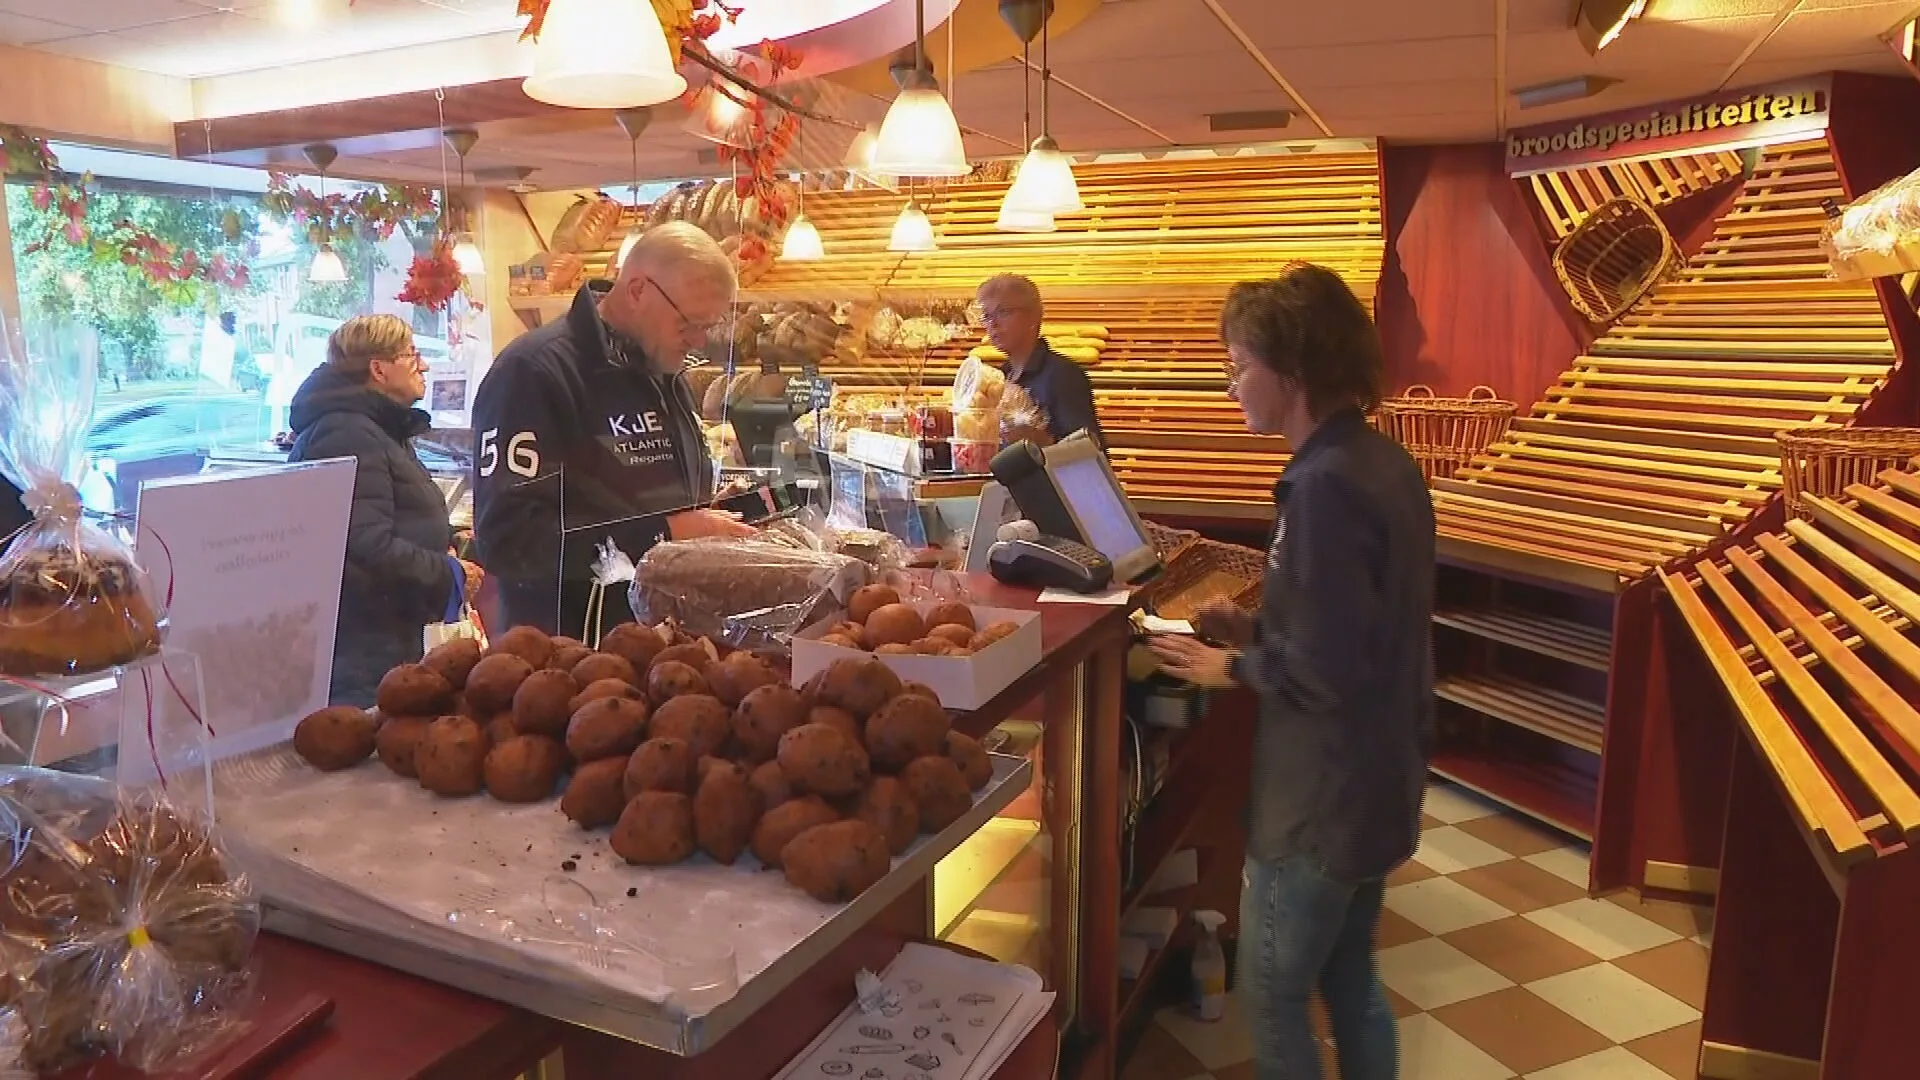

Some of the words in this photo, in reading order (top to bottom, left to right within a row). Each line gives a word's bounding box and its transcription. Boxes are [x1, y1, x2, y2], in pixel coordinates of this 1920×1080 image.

[1507, 90, 1817, 157] broodspecialiteiten
[480, 427, 540, 479] 56
[613, 438, 672, 453] ATLANTIC
[630, 453, 674, 465] Regatta
